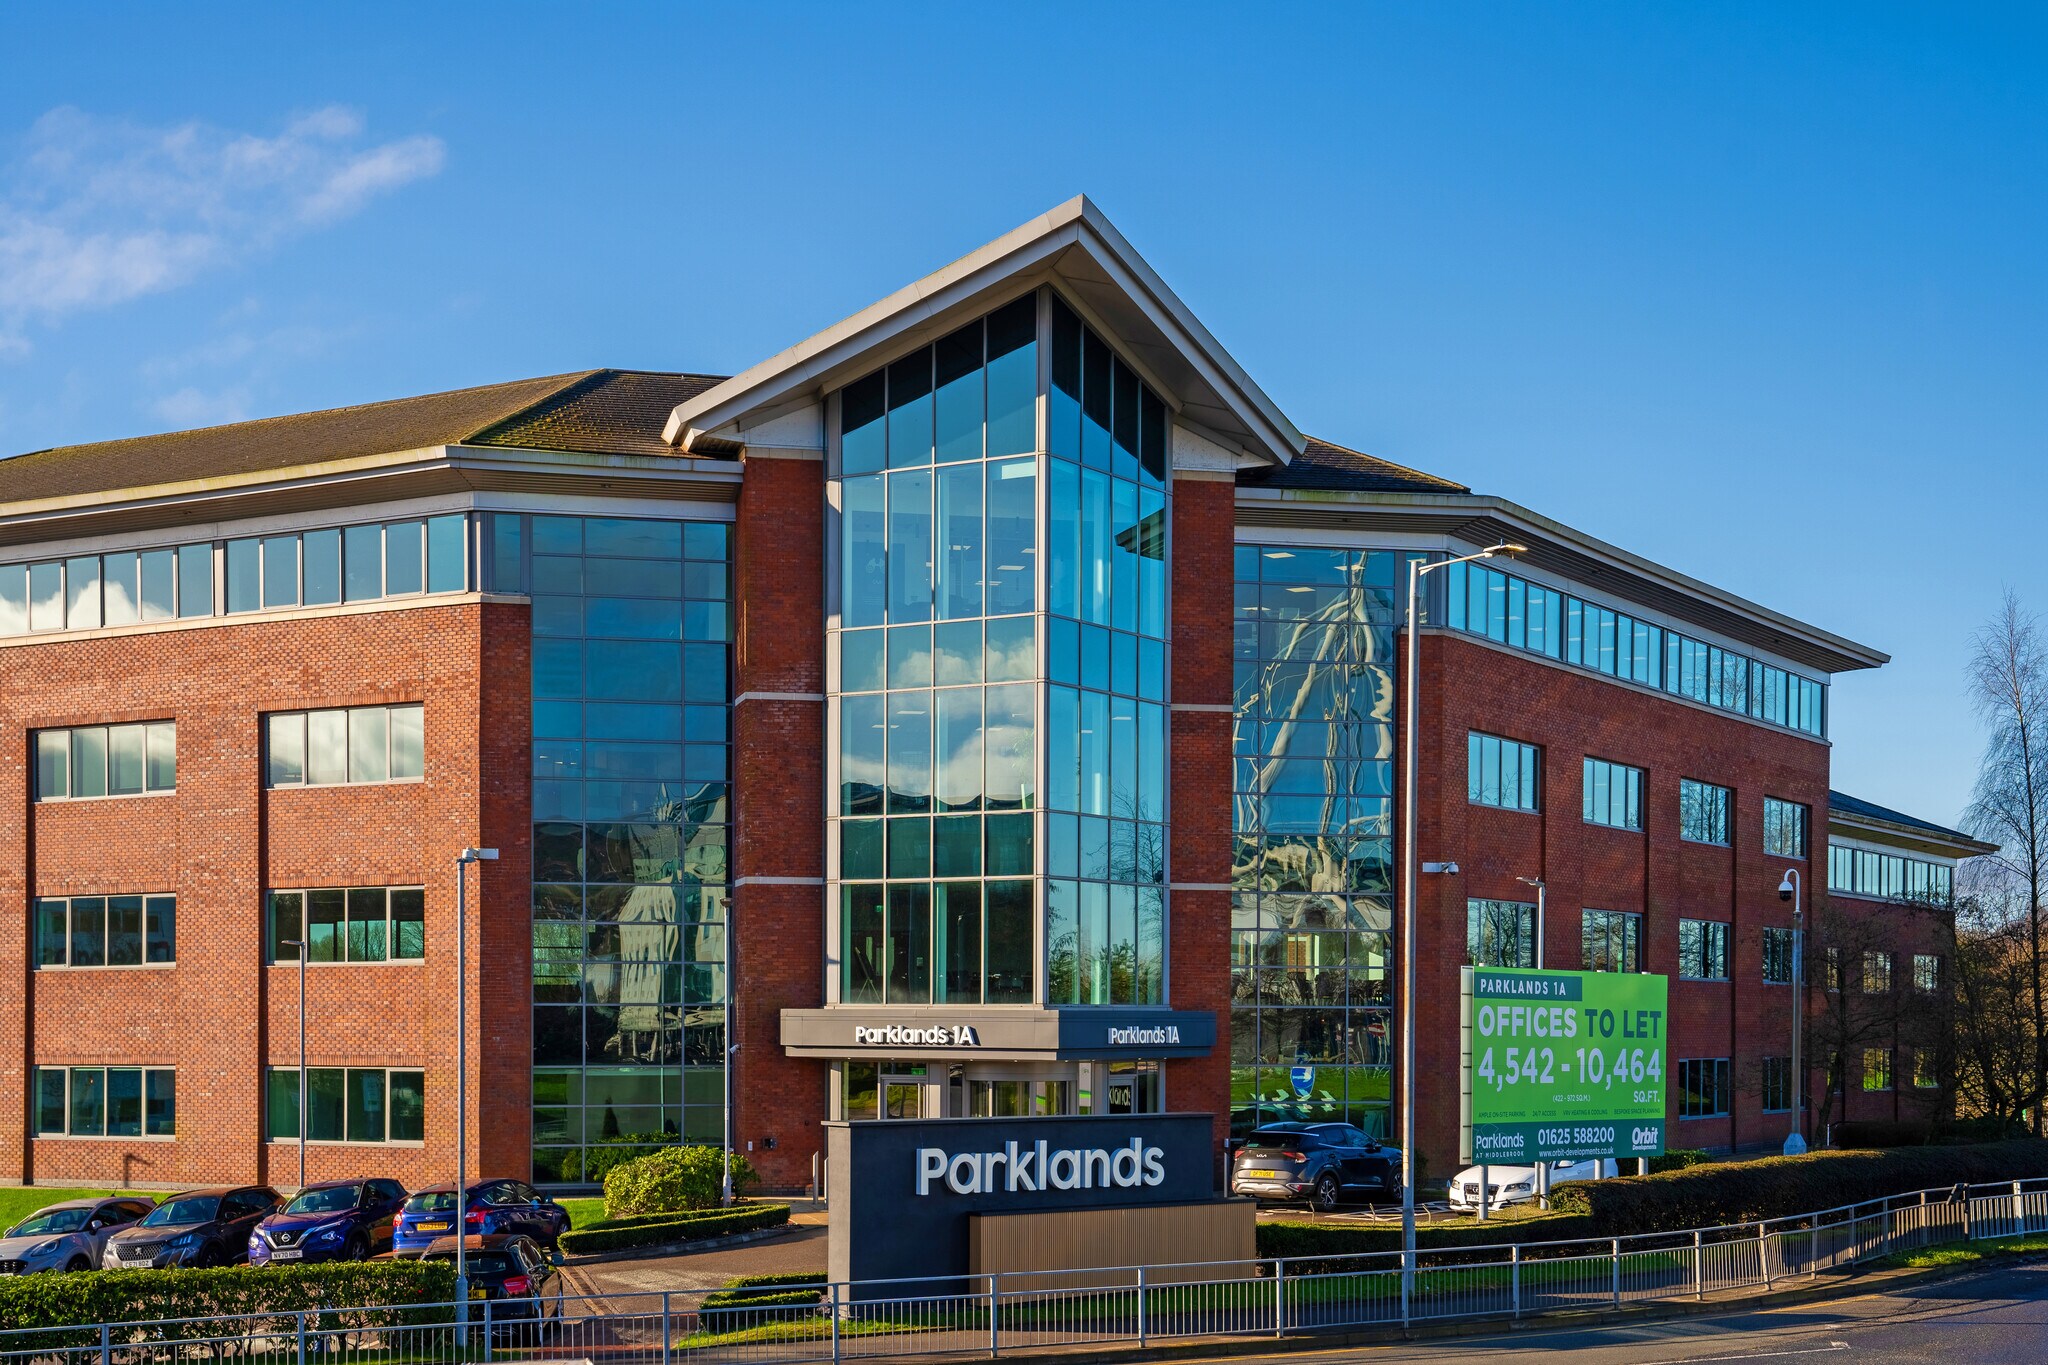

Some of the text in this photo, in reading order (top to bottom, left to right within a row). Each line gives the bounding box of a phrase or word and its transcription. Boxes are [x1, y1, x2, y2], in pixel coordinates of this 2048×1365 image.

[1480, 979, 1567, 996] PARKLANDS 1A
[1478, 1005, 1662, 1039] OFFICES TO LET
[856, 1025, 977, 1045] Parklands 1A
[1108, 1026, 1180, 1044] Parklands 1A
[1478, 1047, 1661, 1092] 4,542 - 10,464
[1633, 1090, 1660, 1103] SQ.FT.
[1476, 1132, 1524, 1149] Parklands
[1537, 1127, 1615, 1145] 01625 588200
[1632, 1127, 1658, 1145] Orbit
[1486, 1150, 1524, 1158] MIDDLEBROOK
[1538, 1147, 1614, 1157] www.orbit-developments.co.uk
[916, 1137, 1164, 1196] Parklands
